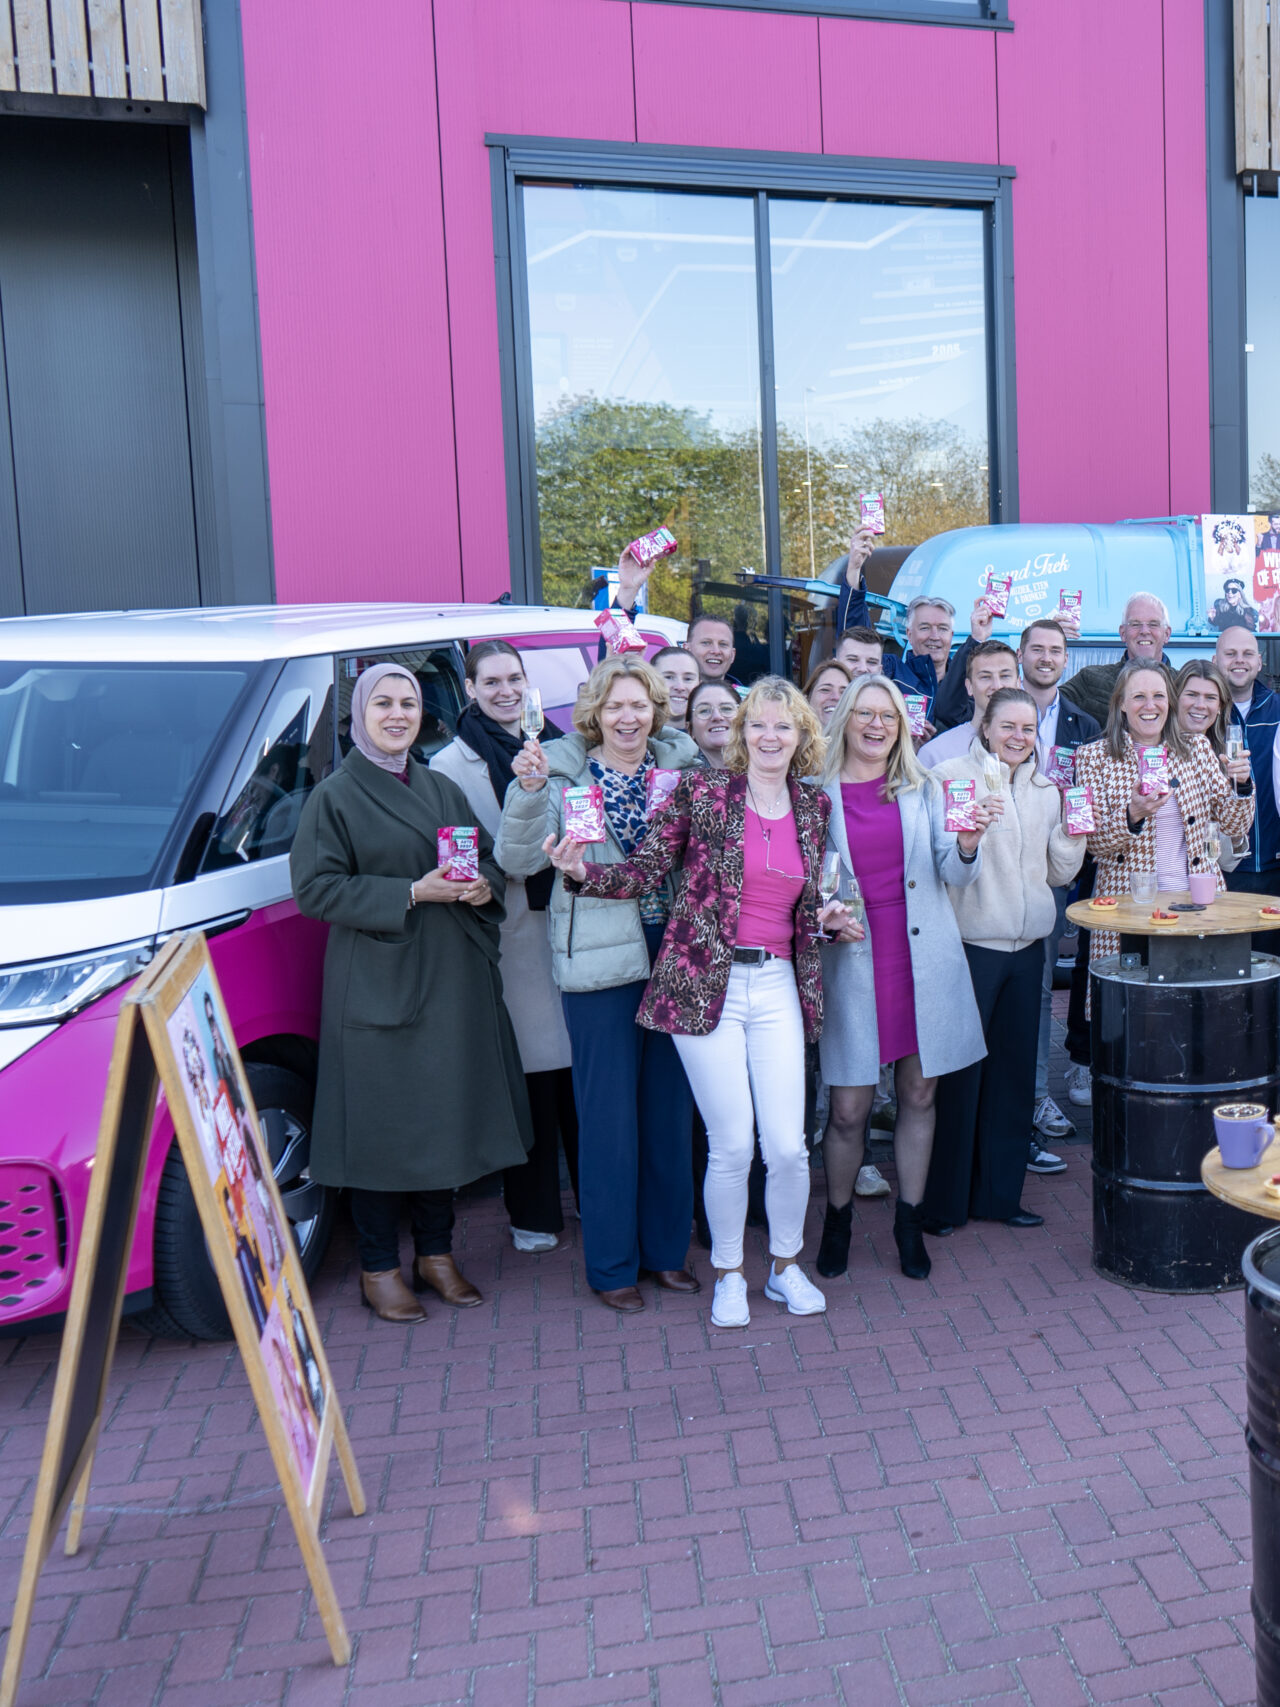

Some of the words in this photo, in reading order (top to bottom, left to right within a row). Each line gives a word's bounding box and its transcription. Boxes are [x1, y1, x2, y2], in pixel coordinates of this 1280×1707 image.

[978, 560, 1032, 588] Snd
[1032, 552, 1071, 577] Trek
[1256, 569, 1270, 586] OF
